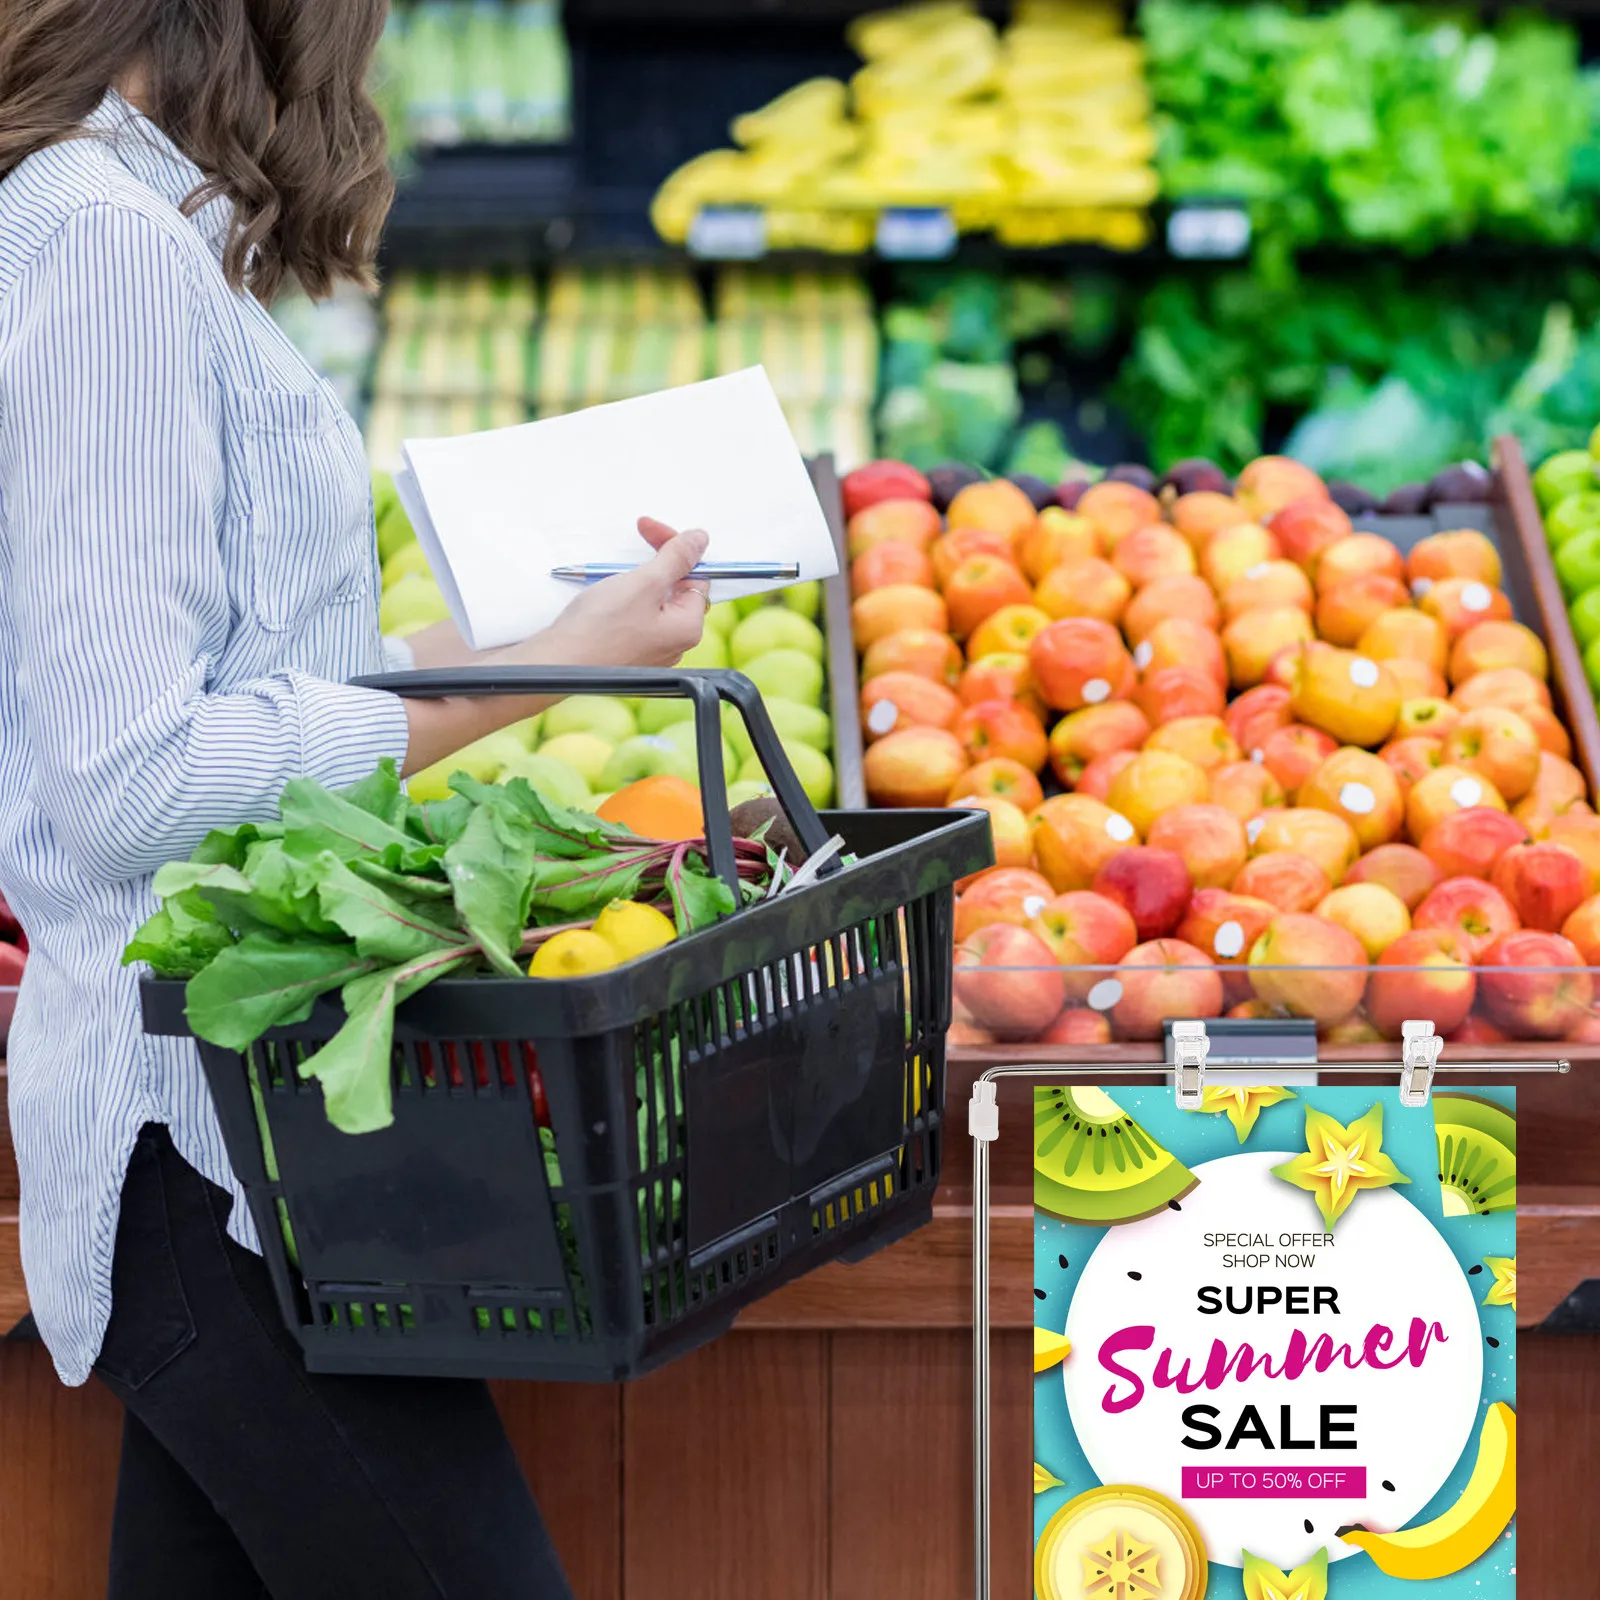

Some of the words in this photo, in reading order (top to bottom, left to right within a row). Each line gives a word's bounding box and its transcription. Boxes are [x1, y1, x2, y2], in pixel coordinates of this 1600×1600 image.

[1203, 1232, 1275, 1248] SPECIAL
[1278, 1232, 1336, 1247] OFFER
[1222, 1253, 1271, 1268] SHOP
[1275, 1253, 1316, 1268] NOW
[1197, 1286, 1341, 1315] SUPER
[1098, 1317, 1449, 1414] Summer
[1181, 1404, 1358, 1450] SALE
[1196, 1472, 1224, 1489] UP
[1229, 1472, 1257, 1489] TO
[1262, 1472, 1303, 1489] 50%
[1307, 1472, 1346, 1489] OFF
